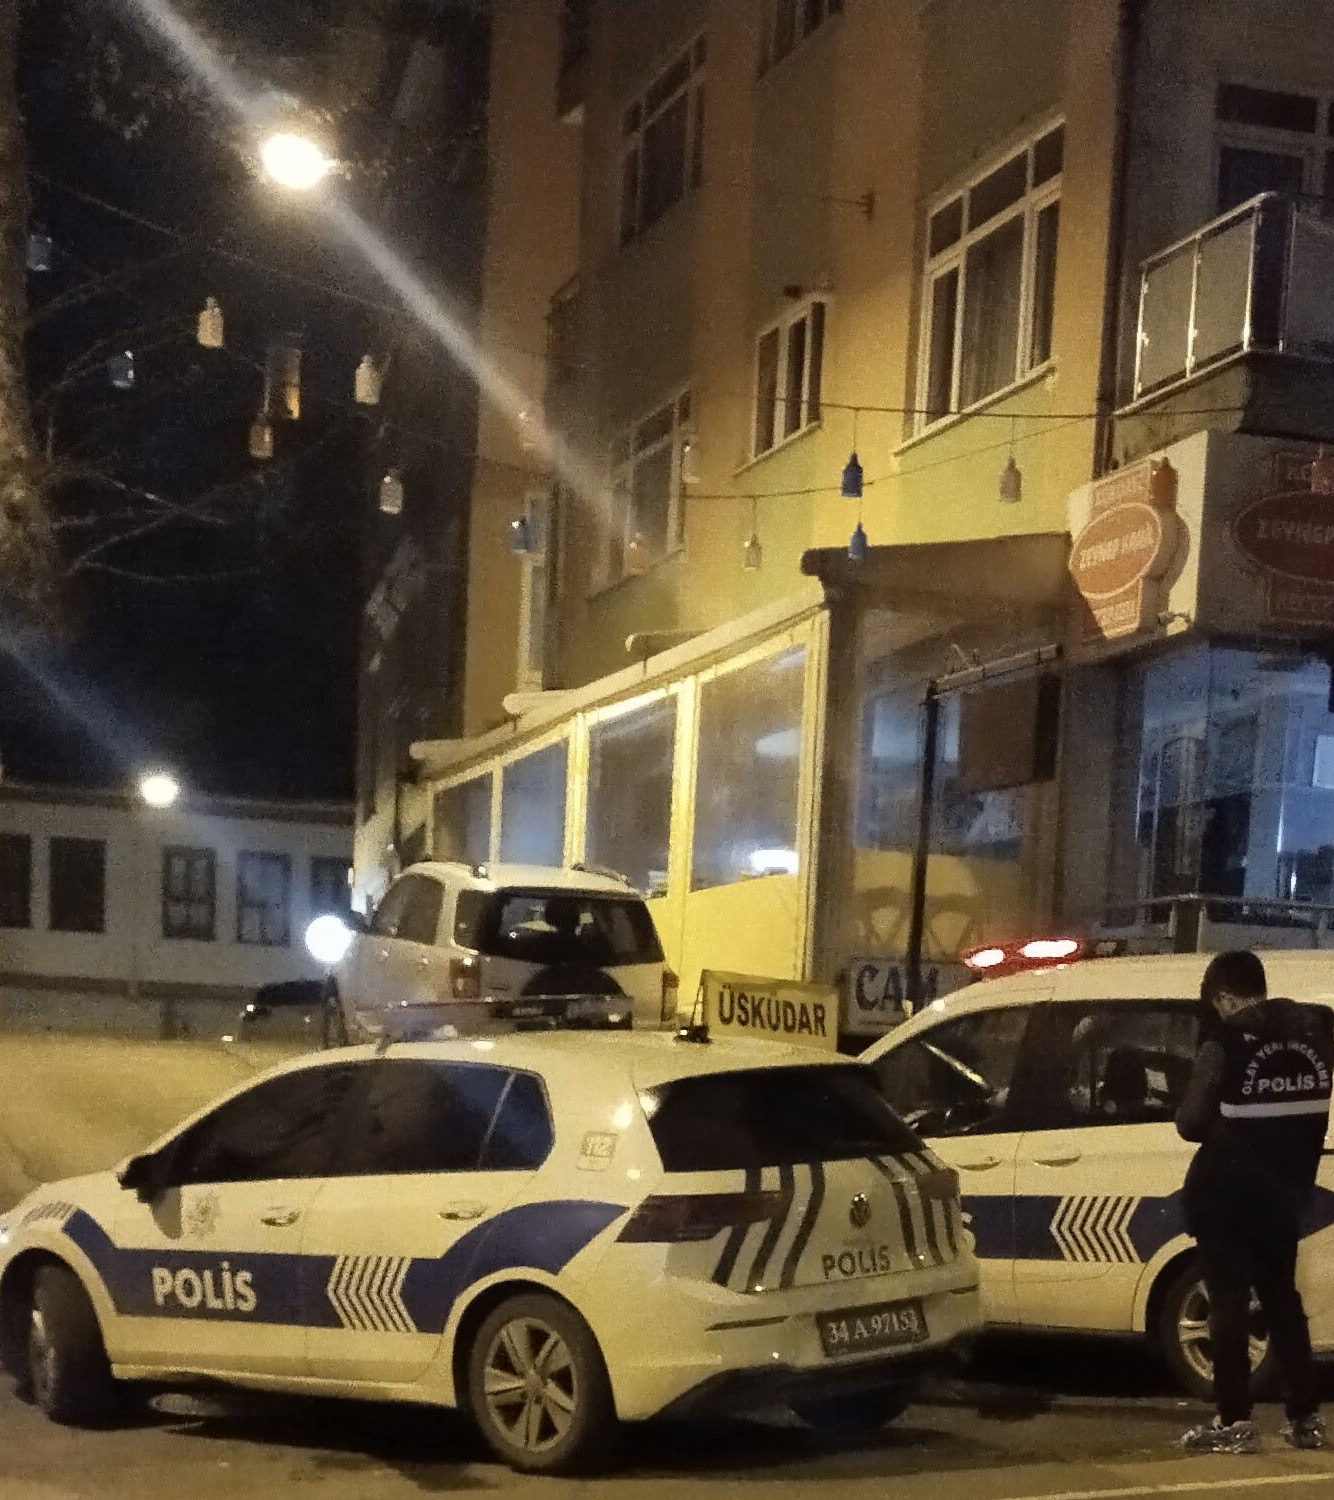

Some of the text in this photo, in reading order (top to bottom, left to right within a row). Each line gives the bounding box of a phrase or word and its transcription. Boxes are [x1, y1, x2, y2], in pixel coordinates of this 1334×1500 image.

[718, 985, 828, 1037] ÜSKÜDAR
[1257, 1072, 1315, 1093] POLİS
[151, 1261, 257, 1312] POLİS
[827, 1319, 849, 1344] 34
[854, 1318, 869, 1340] A
